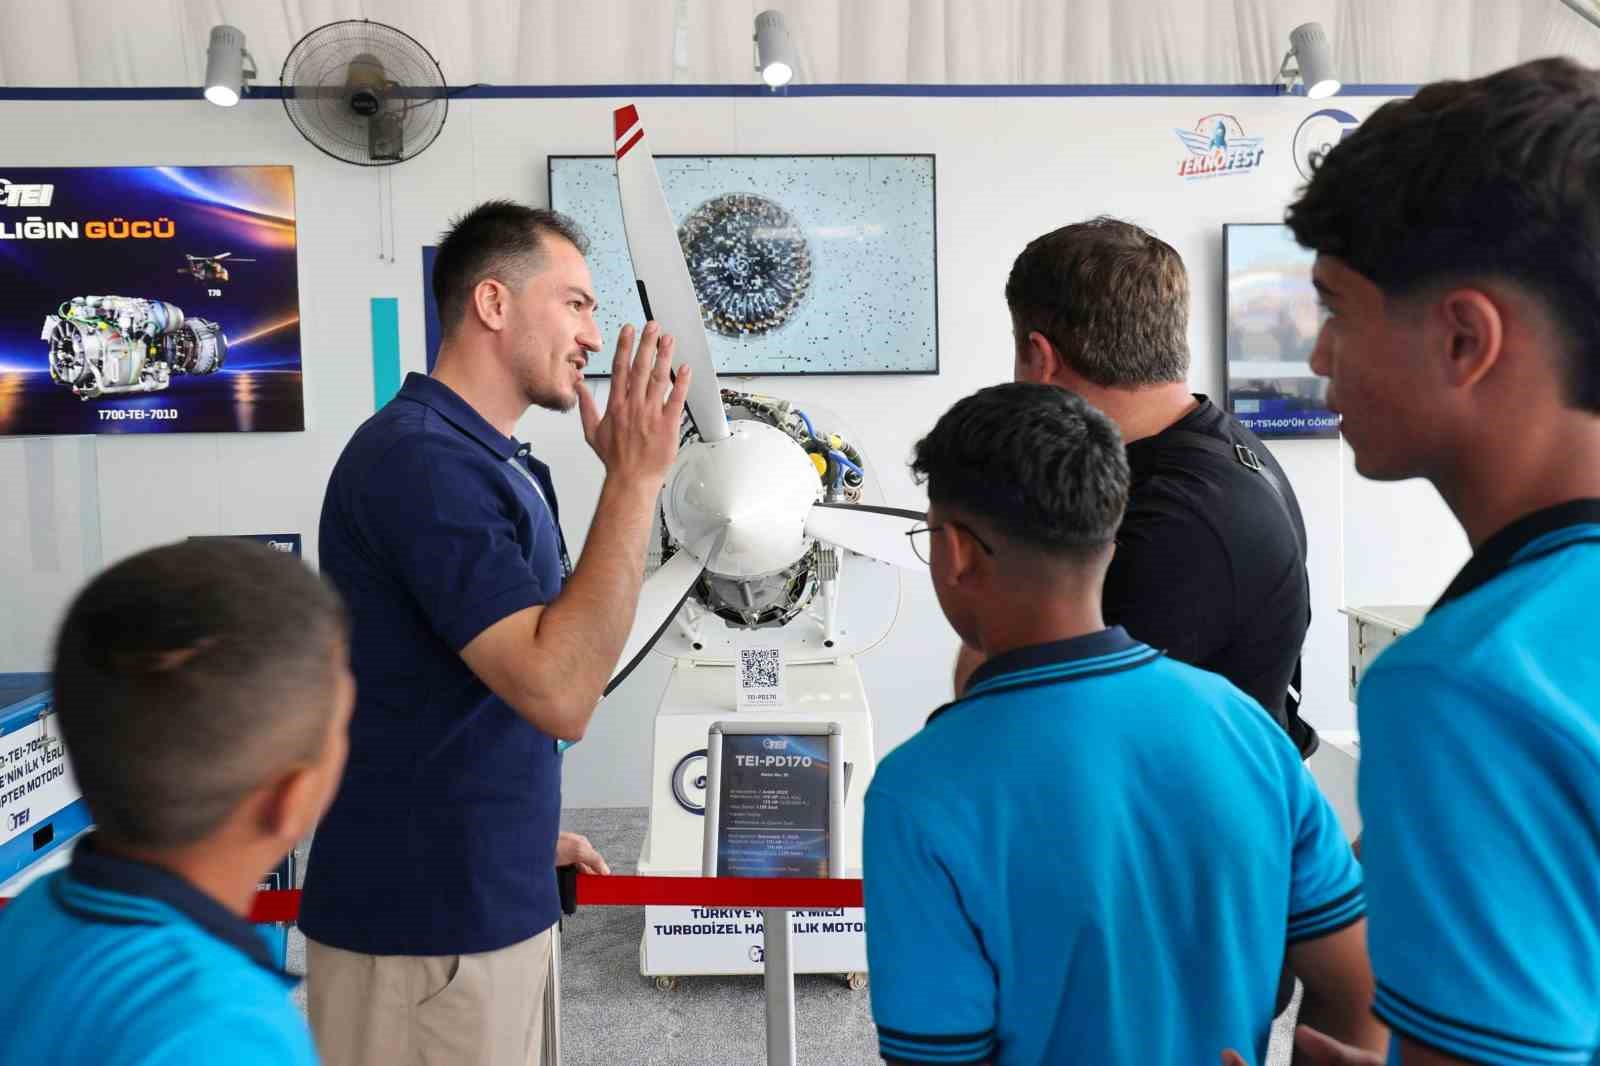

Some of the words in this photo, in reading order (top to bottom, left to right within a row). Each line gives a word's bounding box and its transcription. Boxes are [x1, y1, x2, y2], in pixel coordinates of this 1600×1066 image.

[1177, 149, 1264, 176] TEKNOFEST
[4, 184, 54, 207] TEI
[85, 217, 176, 239] GÜCÜ
[735, 755, 813, 768] TEI-PD170
[0, 784, 26, 808] PTER
[27, 762, 65, 793] MOTORU
[13, 808, 30, 829] TEI
[653, 922, 742, 935] TURBODİZEL
[823, 922, 865, 933] MOTO
